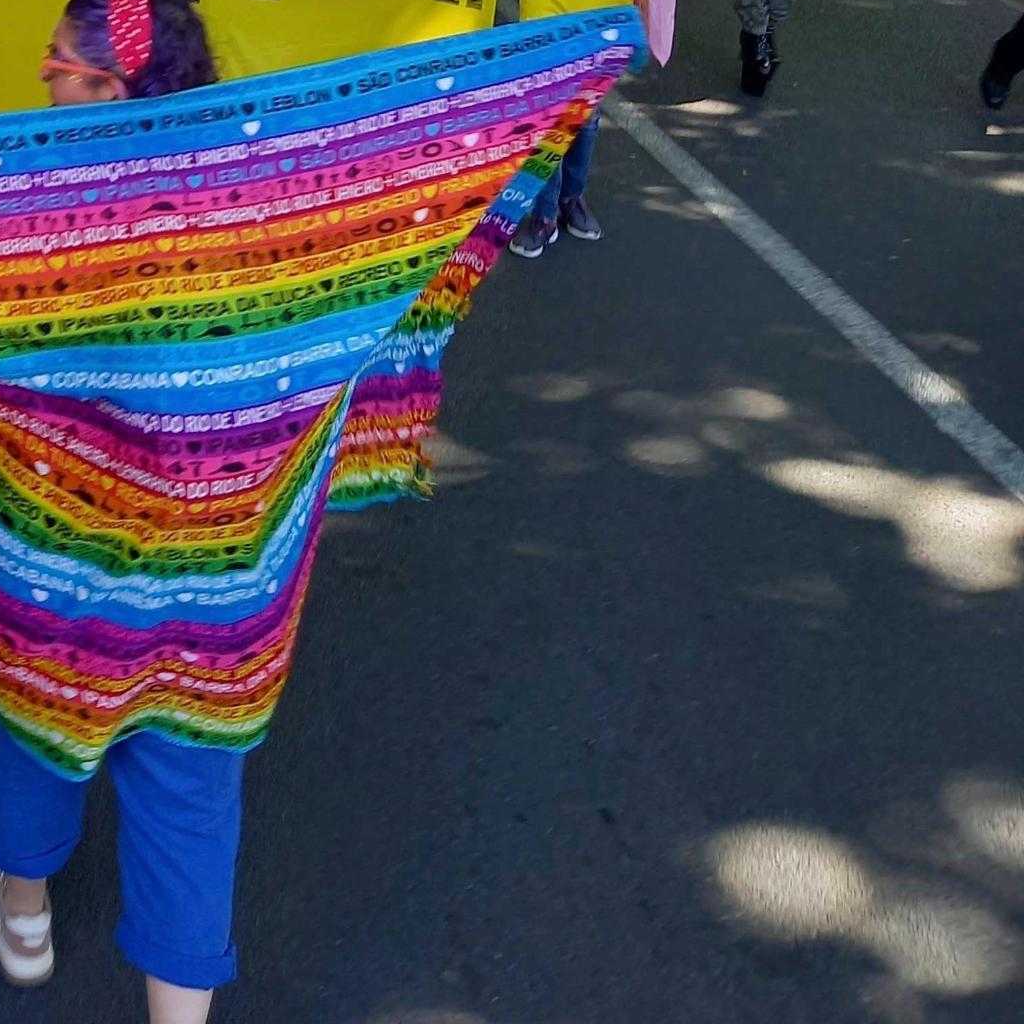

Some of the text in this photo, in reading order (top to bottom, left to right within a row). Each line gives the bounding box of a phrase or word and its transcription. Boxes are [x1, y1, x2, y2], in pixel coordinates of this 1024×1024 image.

[54, 120, 135, 145] RECREIO
[263, 85, 331, 114] LEBLON
[357, 66, 391, 93] SÃO
[396, 49, 477, 83] CONRADO
[499, 28, 554, 58] BARRA
[559, 20, 581, 41] DA
[127, 157, 150, 175] DO
[150, 154, 175, 172] RIO
[175, 151, 196, 170] DE
[176, 229, 238, 252] BARRA
[166, 300, 231, 321] BARRA
[235, 293, 258, 314] DA
[260, 282, 318, 308] TIJUCA
[50, 370, 172, 389] COPACABANA
[288, 338, 345, 367] BARRA
